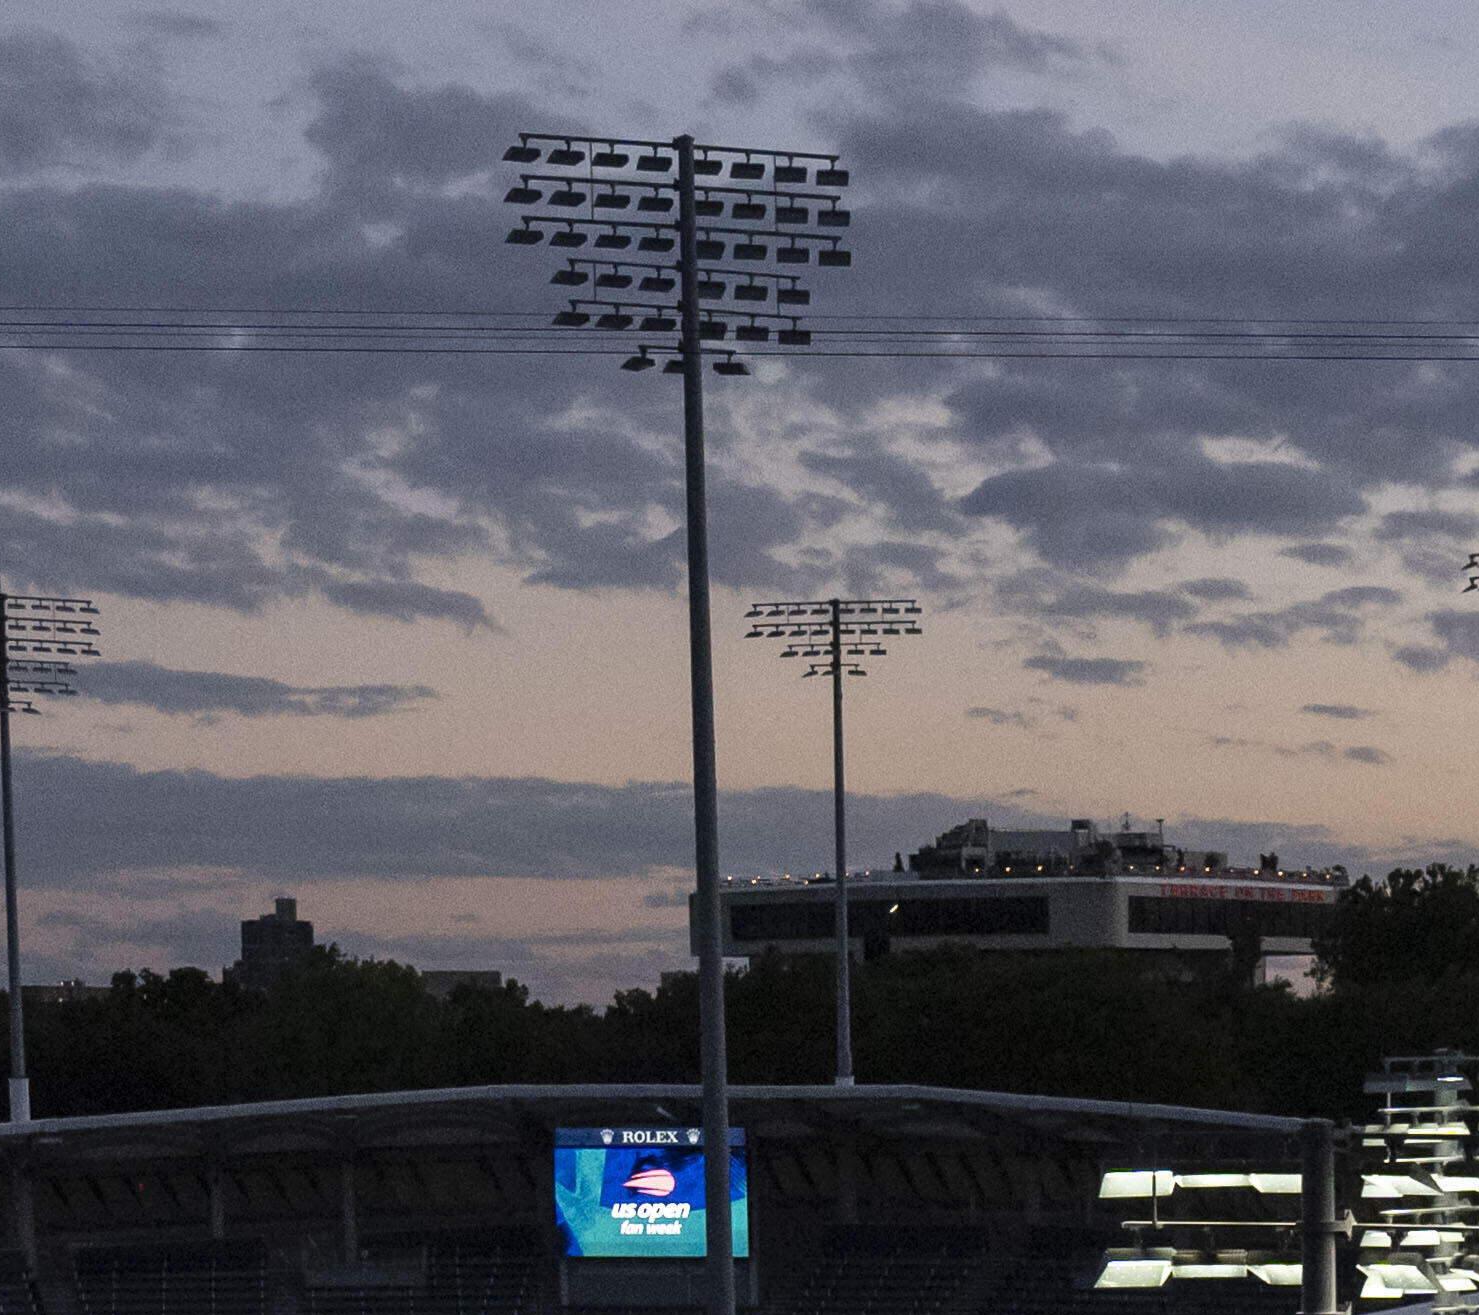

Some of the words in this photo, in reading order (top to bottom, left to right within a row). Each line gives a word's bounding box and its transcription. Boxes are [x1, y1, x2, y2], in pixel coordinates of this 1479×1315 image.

[622, 1131, 678, 1143] ROLEX
[611, 1203, 636, 1218] us
[637, 1203, 691, 1223] open
[621, 1221, 644, 1234] fan
[646, 1221, 682, 1234] week
